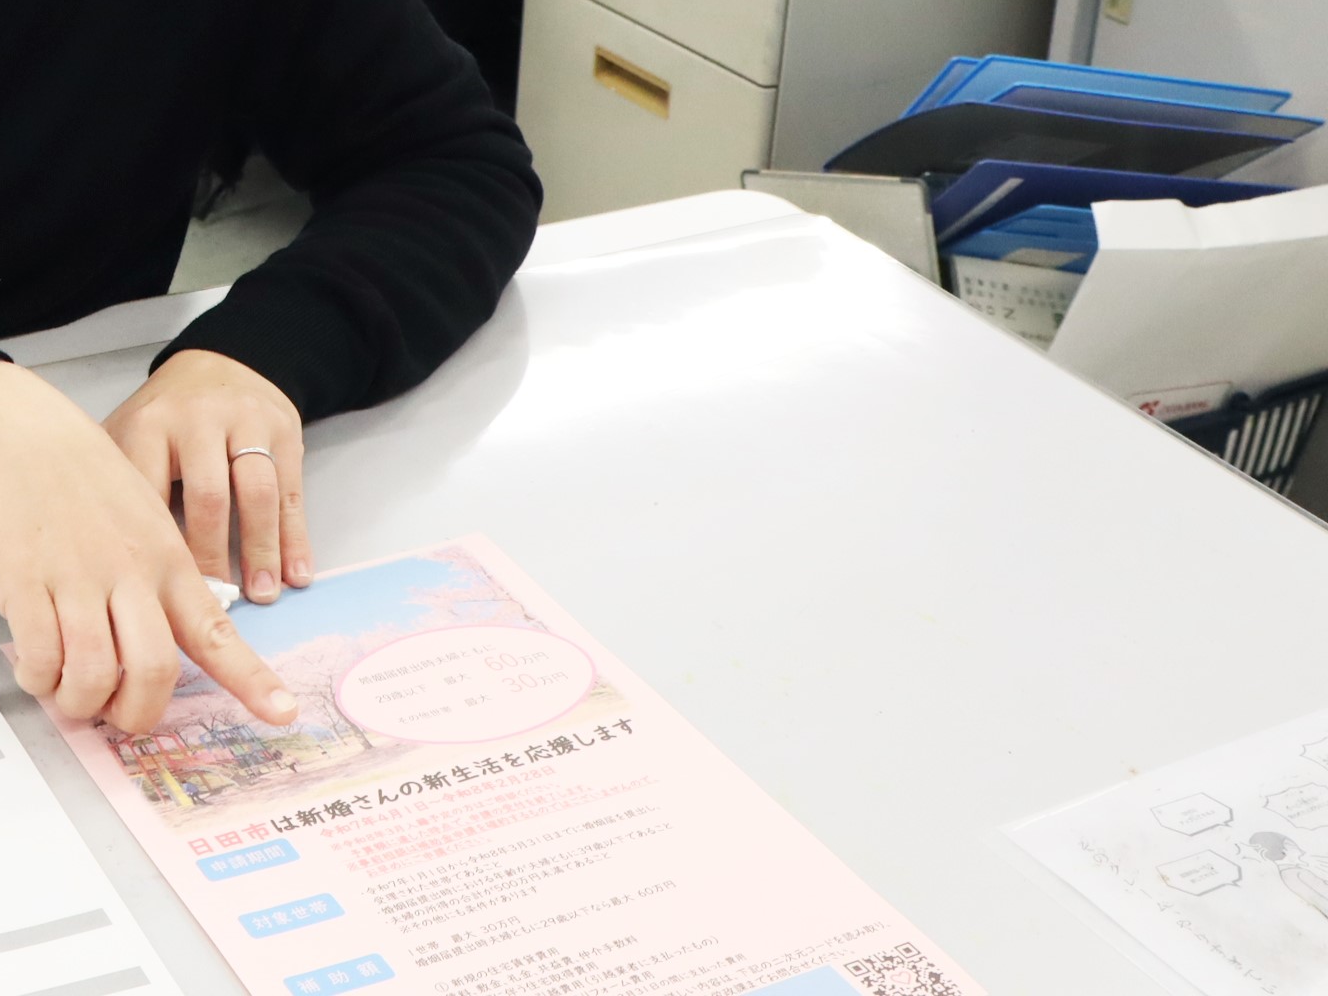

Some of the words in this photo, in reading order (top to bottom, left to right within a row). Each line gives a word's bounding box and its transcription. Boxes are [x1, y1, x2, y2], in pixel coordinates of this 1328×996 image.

[375, 683, 428, 704] 29歳以下
[443, 672, 472, 686] 最大
[464, 692, 493, 708] 最大
[186, 716, 635, 856] 日田市は新婚さんの新生活を応援します
[209, 844, 285, 873] 申請期間
[637, 879, 678, 898] 60万円
[251, 899, 328, 931] 対象世帯
[480, 915, 521, 934] 30万円
